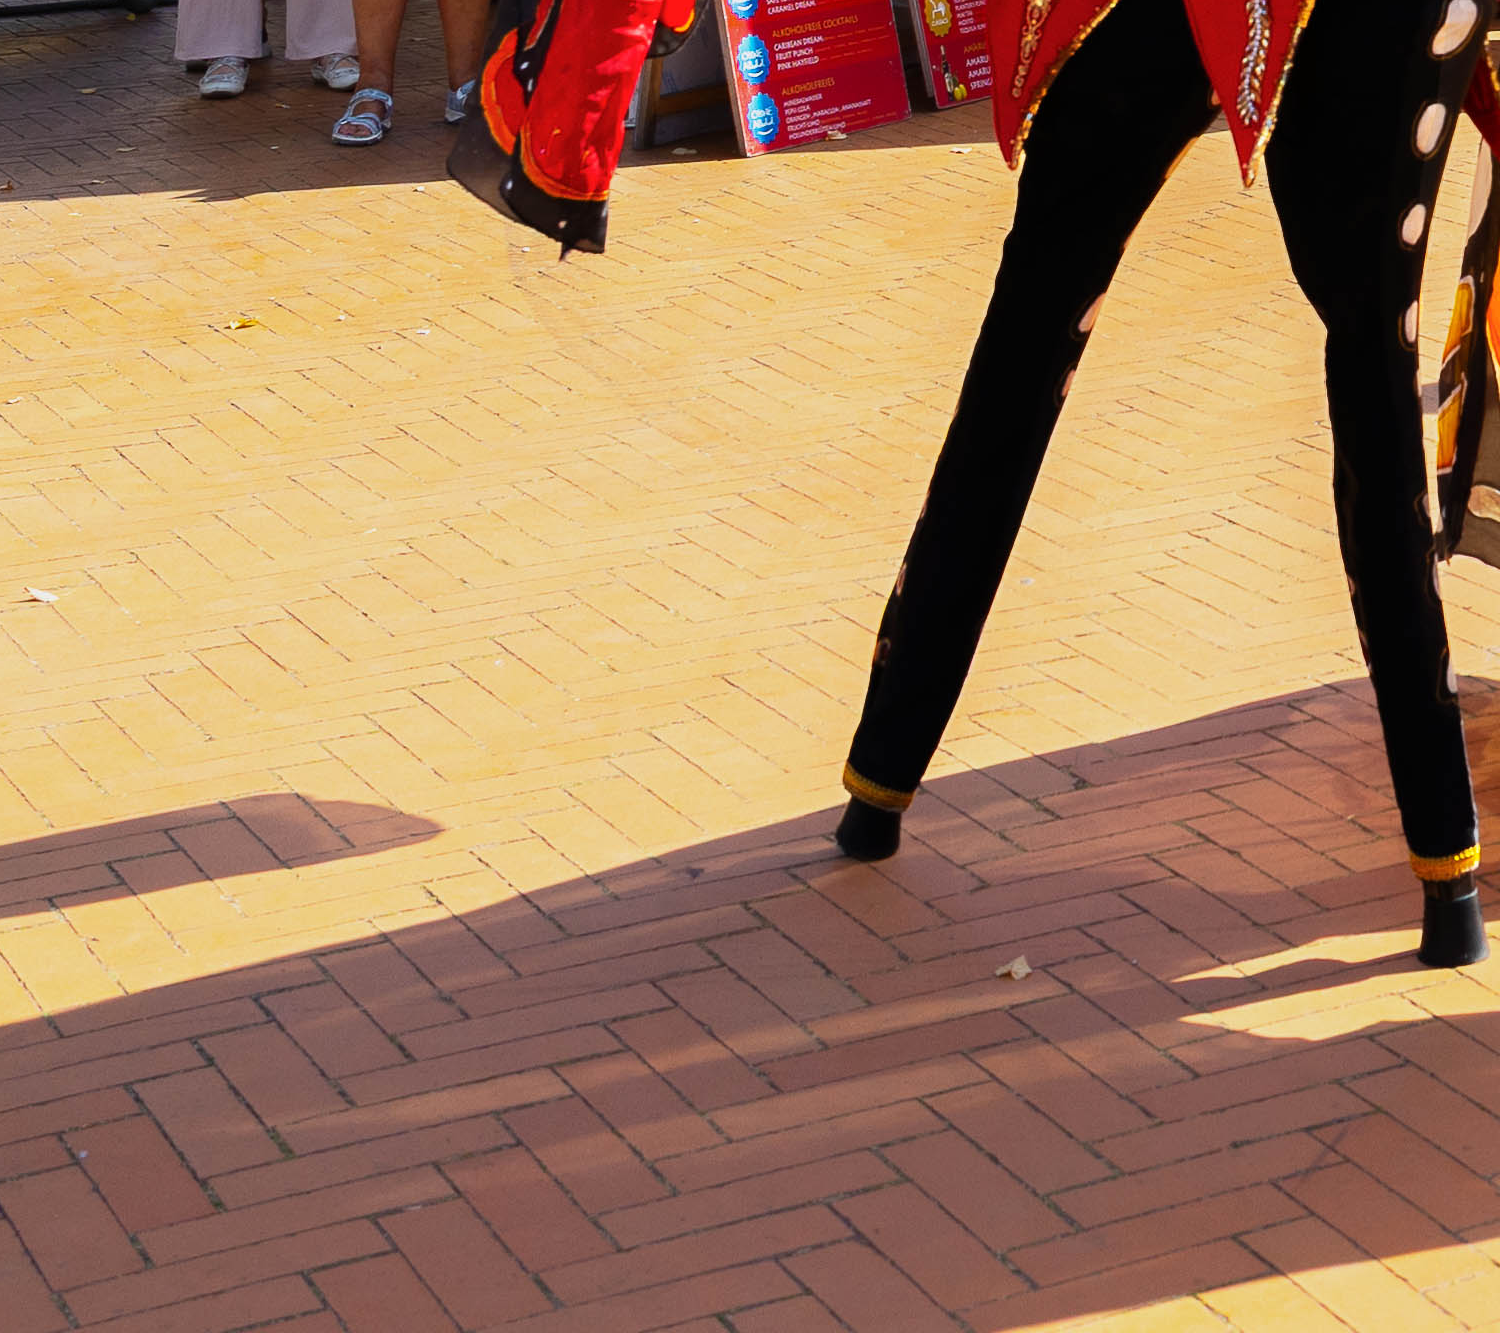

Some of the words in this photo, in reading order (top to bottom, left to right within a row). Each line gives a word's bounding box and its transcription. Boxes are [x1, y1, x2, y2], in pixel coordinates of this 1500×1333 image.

[772, 21, 822, 38] ALKOHOLFREIE
[822, 14, 859, 29] COCKTAILS
[966, 55, 989, 67] AMARU
[968, 66, 991, 79] AMARU
